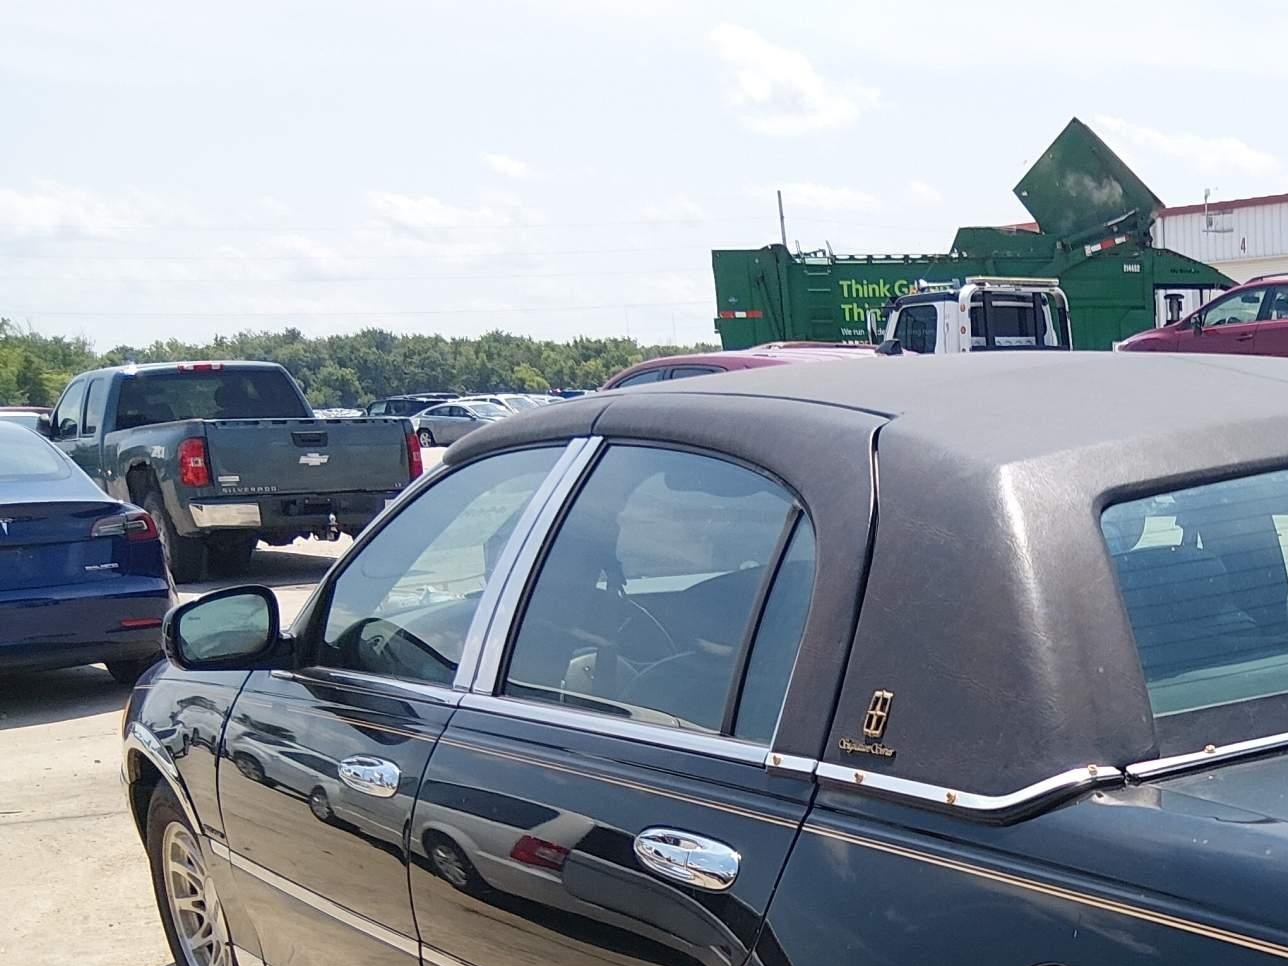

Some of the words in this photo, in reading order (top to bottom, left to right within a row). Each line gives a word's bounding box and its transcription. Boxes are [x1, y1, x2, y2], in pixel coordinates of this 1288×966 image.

[1239, 237, 1247, 254] 4
[839, 279, 891, 298] Think
[222, 486, 277, 494] SILVERADO
